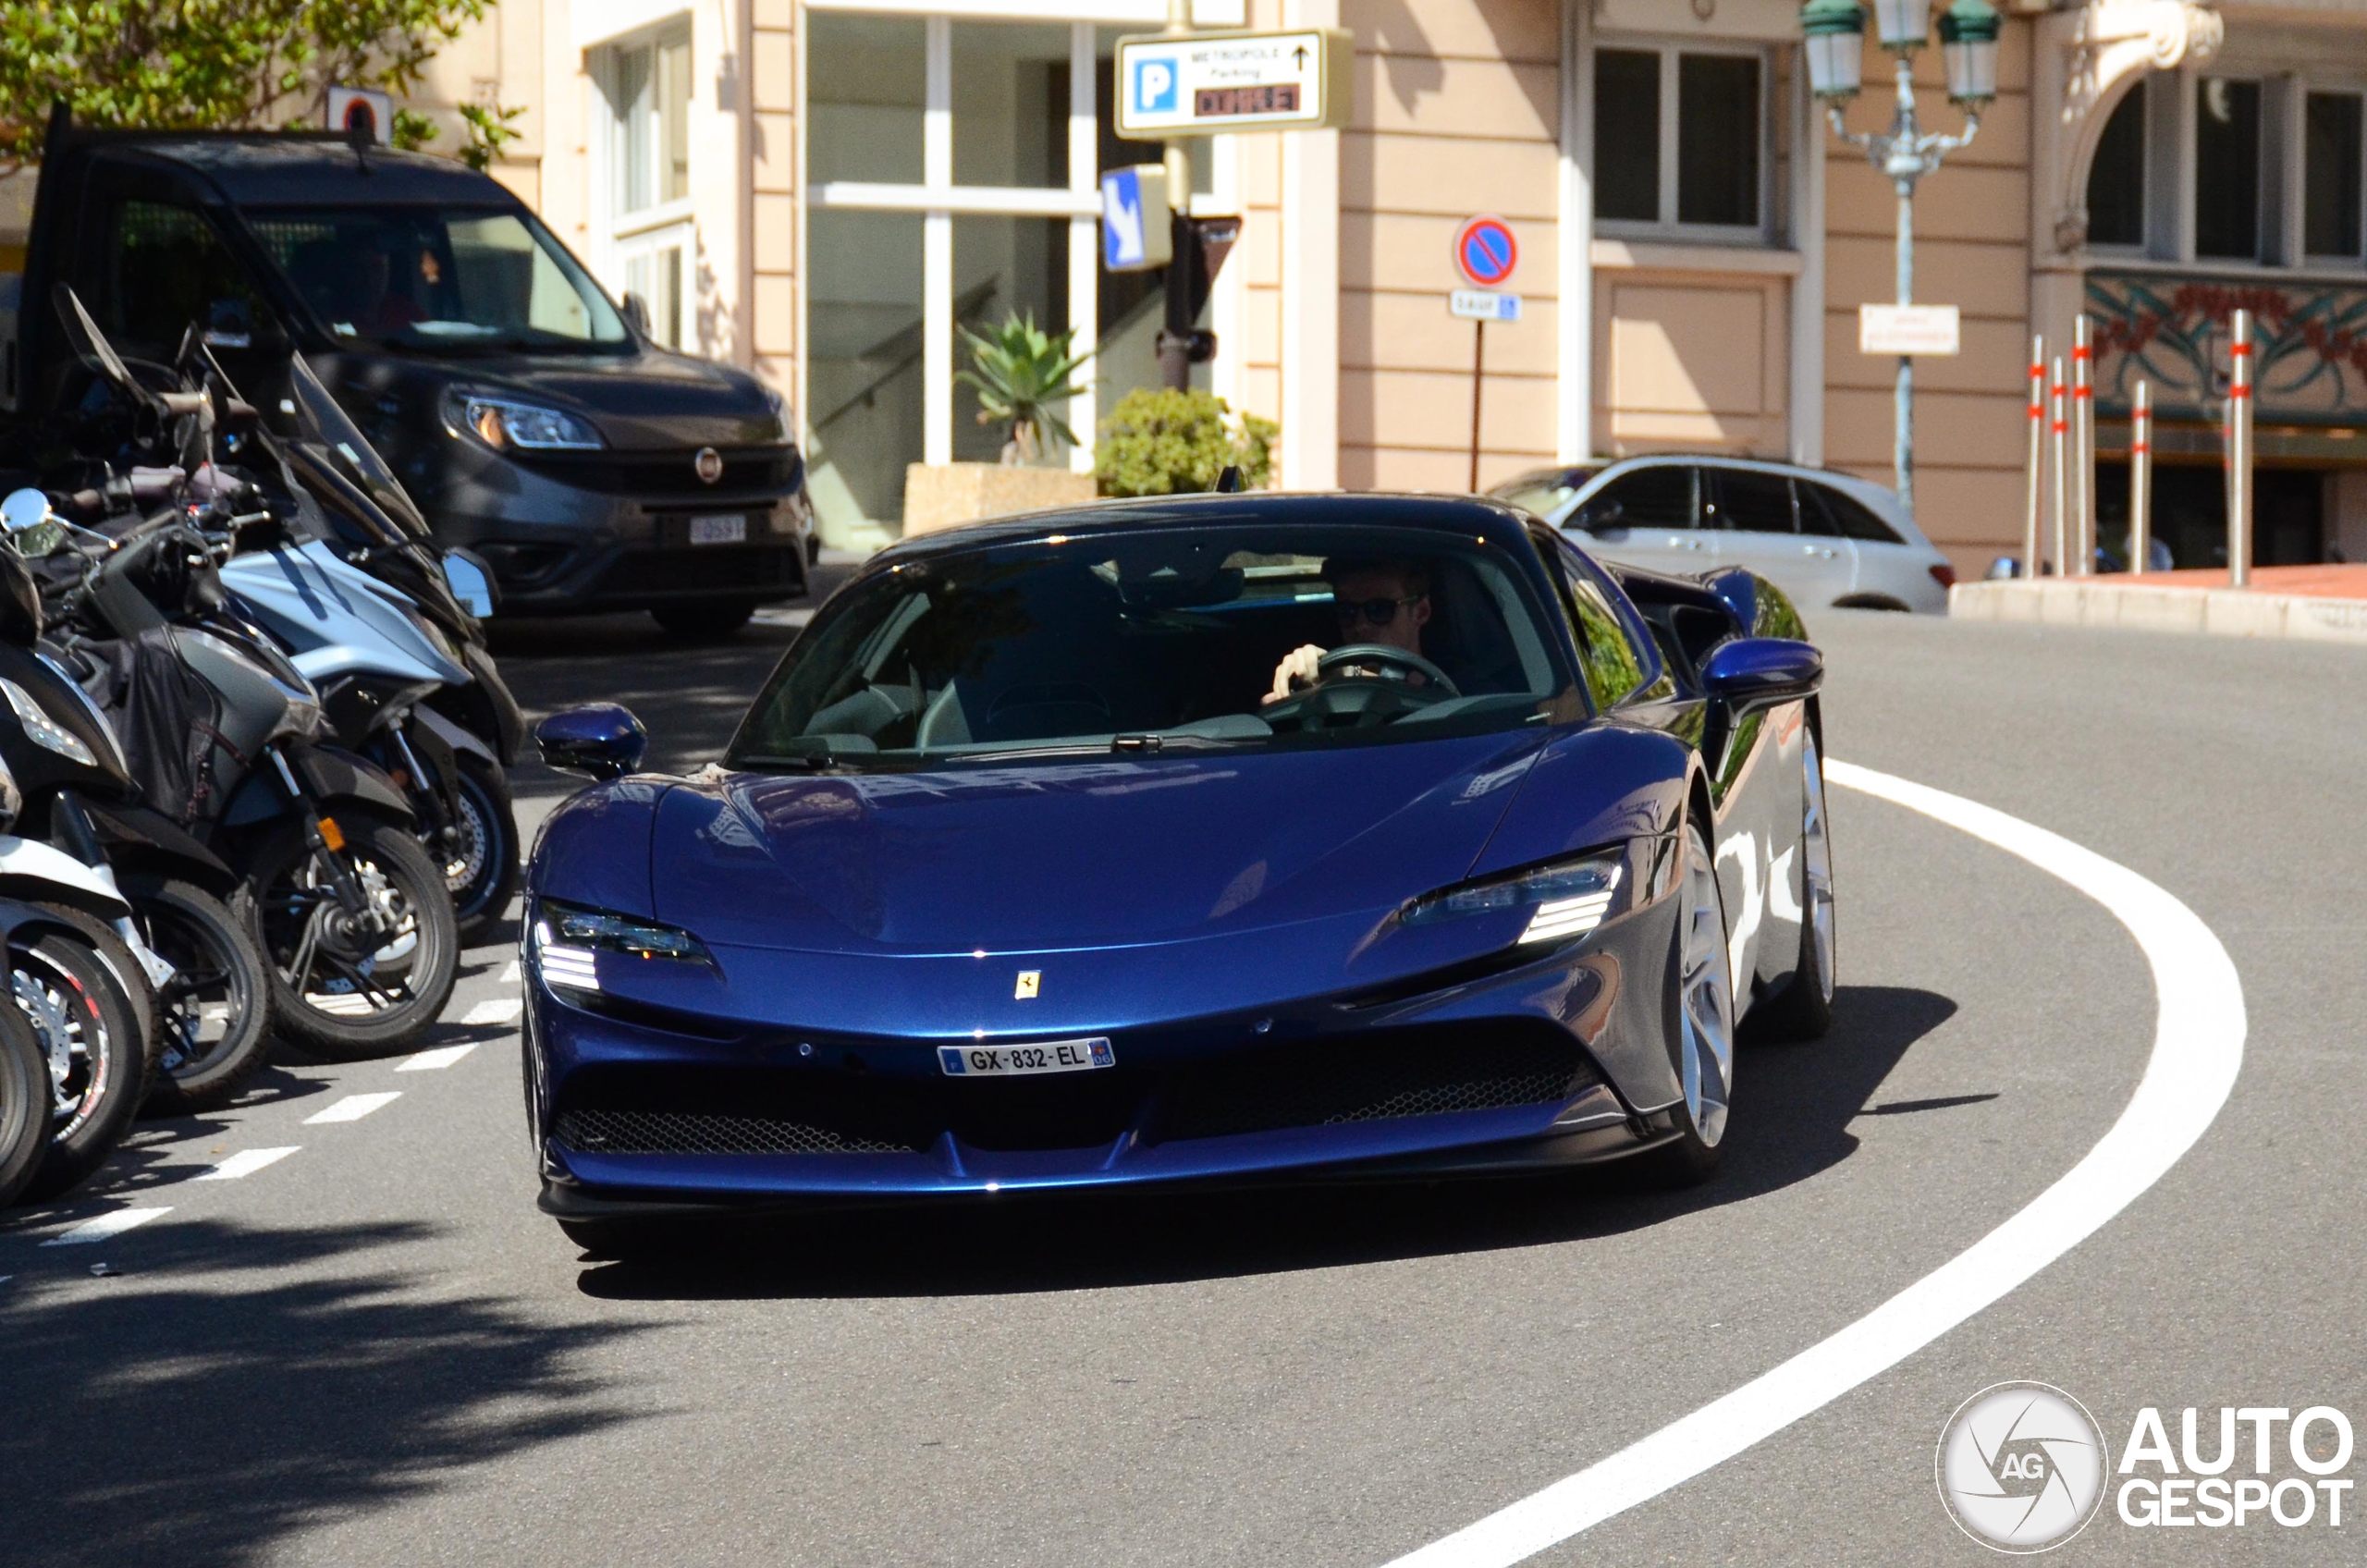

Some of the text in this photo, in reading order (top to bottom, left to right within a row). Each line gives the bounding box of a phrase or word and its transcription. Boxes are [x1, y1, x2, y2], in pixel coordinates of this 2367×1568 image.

[1191, 47, 1279, 63] METROPOLE
[1209, 67, 1261, 80] Parking
[1140, 63, 1171, 109] P
[971, 1046, 1085, 1071] GX-832-EL
